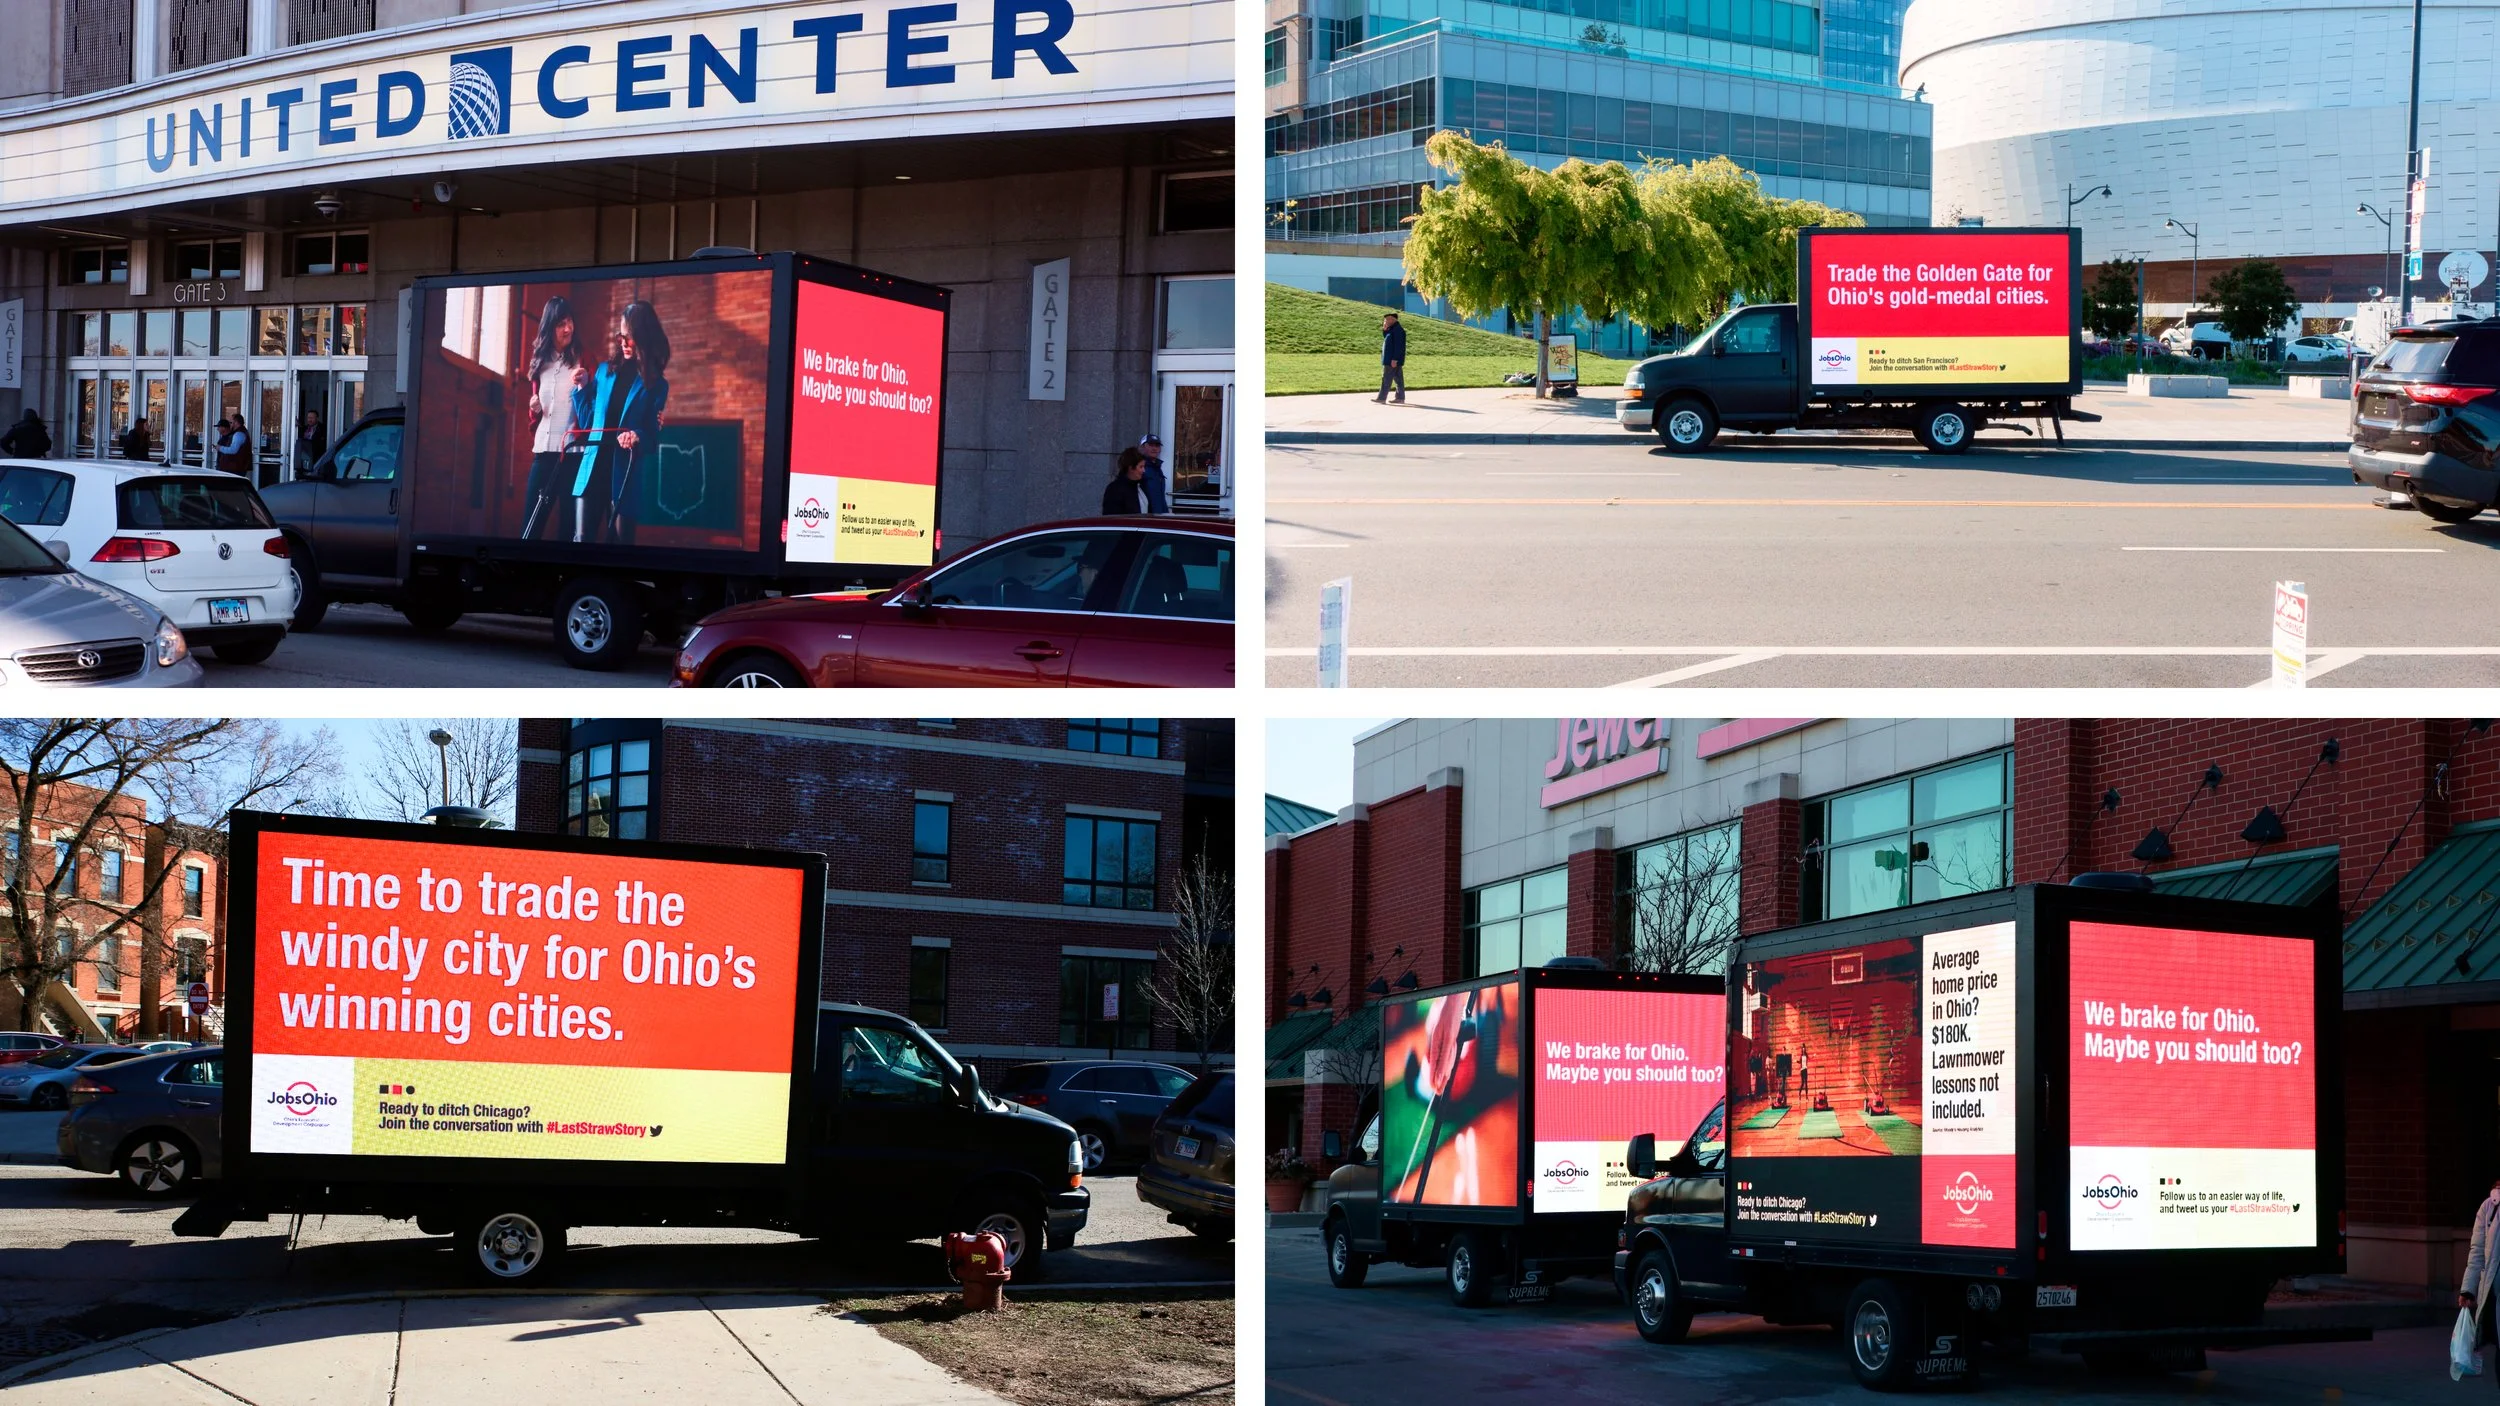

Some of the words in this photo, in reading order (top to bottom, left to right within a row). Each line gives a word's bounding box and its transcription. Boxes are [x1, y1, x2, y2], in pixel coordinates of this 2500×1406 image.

[146, 71, 425, 173] UNITED
[537, 0, 1079, 119] CENTER
[1828, 264, 1877, 281] Trade
[1882, 264, 1911, 282] the
[1916, 263, 1977, 282] Golden
[1983, 263, 2023, 282] Gate
[2028, 263, 2053, 282] for
[174, 283, 210, 302] GATE
[217, 282, 226, 301] 3
[1828, 287, 1884, 305] Ohio's
[1890, 287, 1990, 309] gold-medal
[1996, 287, 2049, 305] cities.
[1043, 274, 1058, 362] GATE
[5, 309, 15, 364] GATE
[804, 348, 822, 371] We
[825, 352, 859, 378] brake
[863, 358, 879, 380] for
[882, 362, 908, 386] Ohio.
[1869, 357, 1888, 366] Ready
[1949, 364, 1998, 372] #LastStrawStory
[5, 369, 13, 381] 3
[1043, 369, 1055, 389] 2
[802, 375, 842, 403] Maybe
[845, 386, 866, 406] you
[869, 387, 906, 410] should
[909, 393, 932, 414] too?
[794, 507, 829, 520] JobsOhio
[842, 514, 857, 523] Follow
[865, 516, 870, 524] to
[871, 517, 877, 525] an
[878, 516, 891, 525] easier
[892, 518, 901, 528] way
[902, 517, 907, 526] of
[908, 517, 916, 528] life,
[282, 857, 400, 911] Time
[417, 867, 462, 915] to
[478, 871, 599, 923] trade
[614, 880, 684, 927] the
[281, 922, 428, 983] windy
[443, 929, 530, 987] city
[544, 934, 608, 982] for
[622, 939, 756, 990] Ohio's
[1932, 950, 1979, 971] Average
[1932, 976, 1964, 995] home
[1967, 971, 1997, 995] price
[279, 987, 470, 1045] winning
[488, 996, 623, 1041] cities.
[1932, 1002, 1942, 1020] in
[1946, 997, 1979, 1019] Ohio?
[2084, 1001, 2115, 1027] We
[2120, 1003, 2176, 1029] brake
[2181, 1006, 2208, 1031] for
[2213, 1007, 2260, 1033] Ohio.
[1932, 1023, 1971, 1046] $180K.
[1546, 1041, 1571, 1059] We
[1575, 1042, 1621, 1060] brake
[1624, 1043, 1647, 1060] for
[1651, 1043, 1689, 1061] Ohio.
[2085, 1032, 2150, 1063] Maybe
[2155, 1040, 2190, 1064] you
[2195, 1038, 2257, 1063] should
[2262, 1042, 2302, 1065] too?
[1932, 1050, 2005, 1069] Lawnmower
[1546, 1063, 1599, 1084] Maybe
[1603, 1068, 1631, 1084] you
[1636, 1065, 1687, 1082] should
[1691, 1066, 1724, 1083] too?
[1932, 1075, 1976, 1094] lessons
[1980, 1072, 1999, 1092] not
[267, 1092, 337, 1106] JobsOhio
[379, 1102, 418, 1116] Ready
[423, 1103, 434, 1116] to
[438, 1103, 469, 1117] ditch
[473, 1104, 531, 1120] Chicago?
[1932, 1099, 1985, 1120] included.
[379, 1116, 406, 1129] Join
[409, 1117, 429, 1130] the
[433, 1118, 513, 1132] conversation
[517, 1120, 543, 1133] with
[546, 1121, 647, 1138] #LastStrawStory
[1543, 1167, 1589, 1177] JobsOhio
[1606, 1171, 1627, 1179] Follow
[1943, 1185, 1993, 1201] JobsOhio
[2082, 1185, 2138, 1199] JobsOhio
[2160, 1191, 2185, 1201] Follow
[2187, 1193, 2196, 1201] us
[2199, 1192, 2207, 1201] to
[2208, 1193, 2218, 1201] an
[2219, 1191, 2242, 1201] easier
[2244, 1193, 2260, 1203] way
[2262, 1191, 2270, 1201] of
[2271, 1191, 2285, 1202] life,
[1737, 1195, 1755, 1209] Ready
[1756, 1197, 1761, 1207] to
[1762, 1196, 1777, 1208] ditch
[1778, 1196, 1806, 1210] Chicago?
[2160, 1204, 2174, 1213] and
[2176, 1204, 2198, 1213] tweet
[2211, 1206, 2228, 1215] your
[2229, 1204, 2290, 1215] #LastStrawStory
[1737, 1209, 1750, 1220] Join
[1750, 1209, 1760, 1221] the
[1760, 1210, 1798, 1222] conversation
[1799, 1211, 1813, 1223] with
[1814, 1211, 1866, 1227] #LastStrawStory
[1508, 1285, 1551, 1299] SUPREME
[1915, 1357, 1968, 1375] SUPREME
